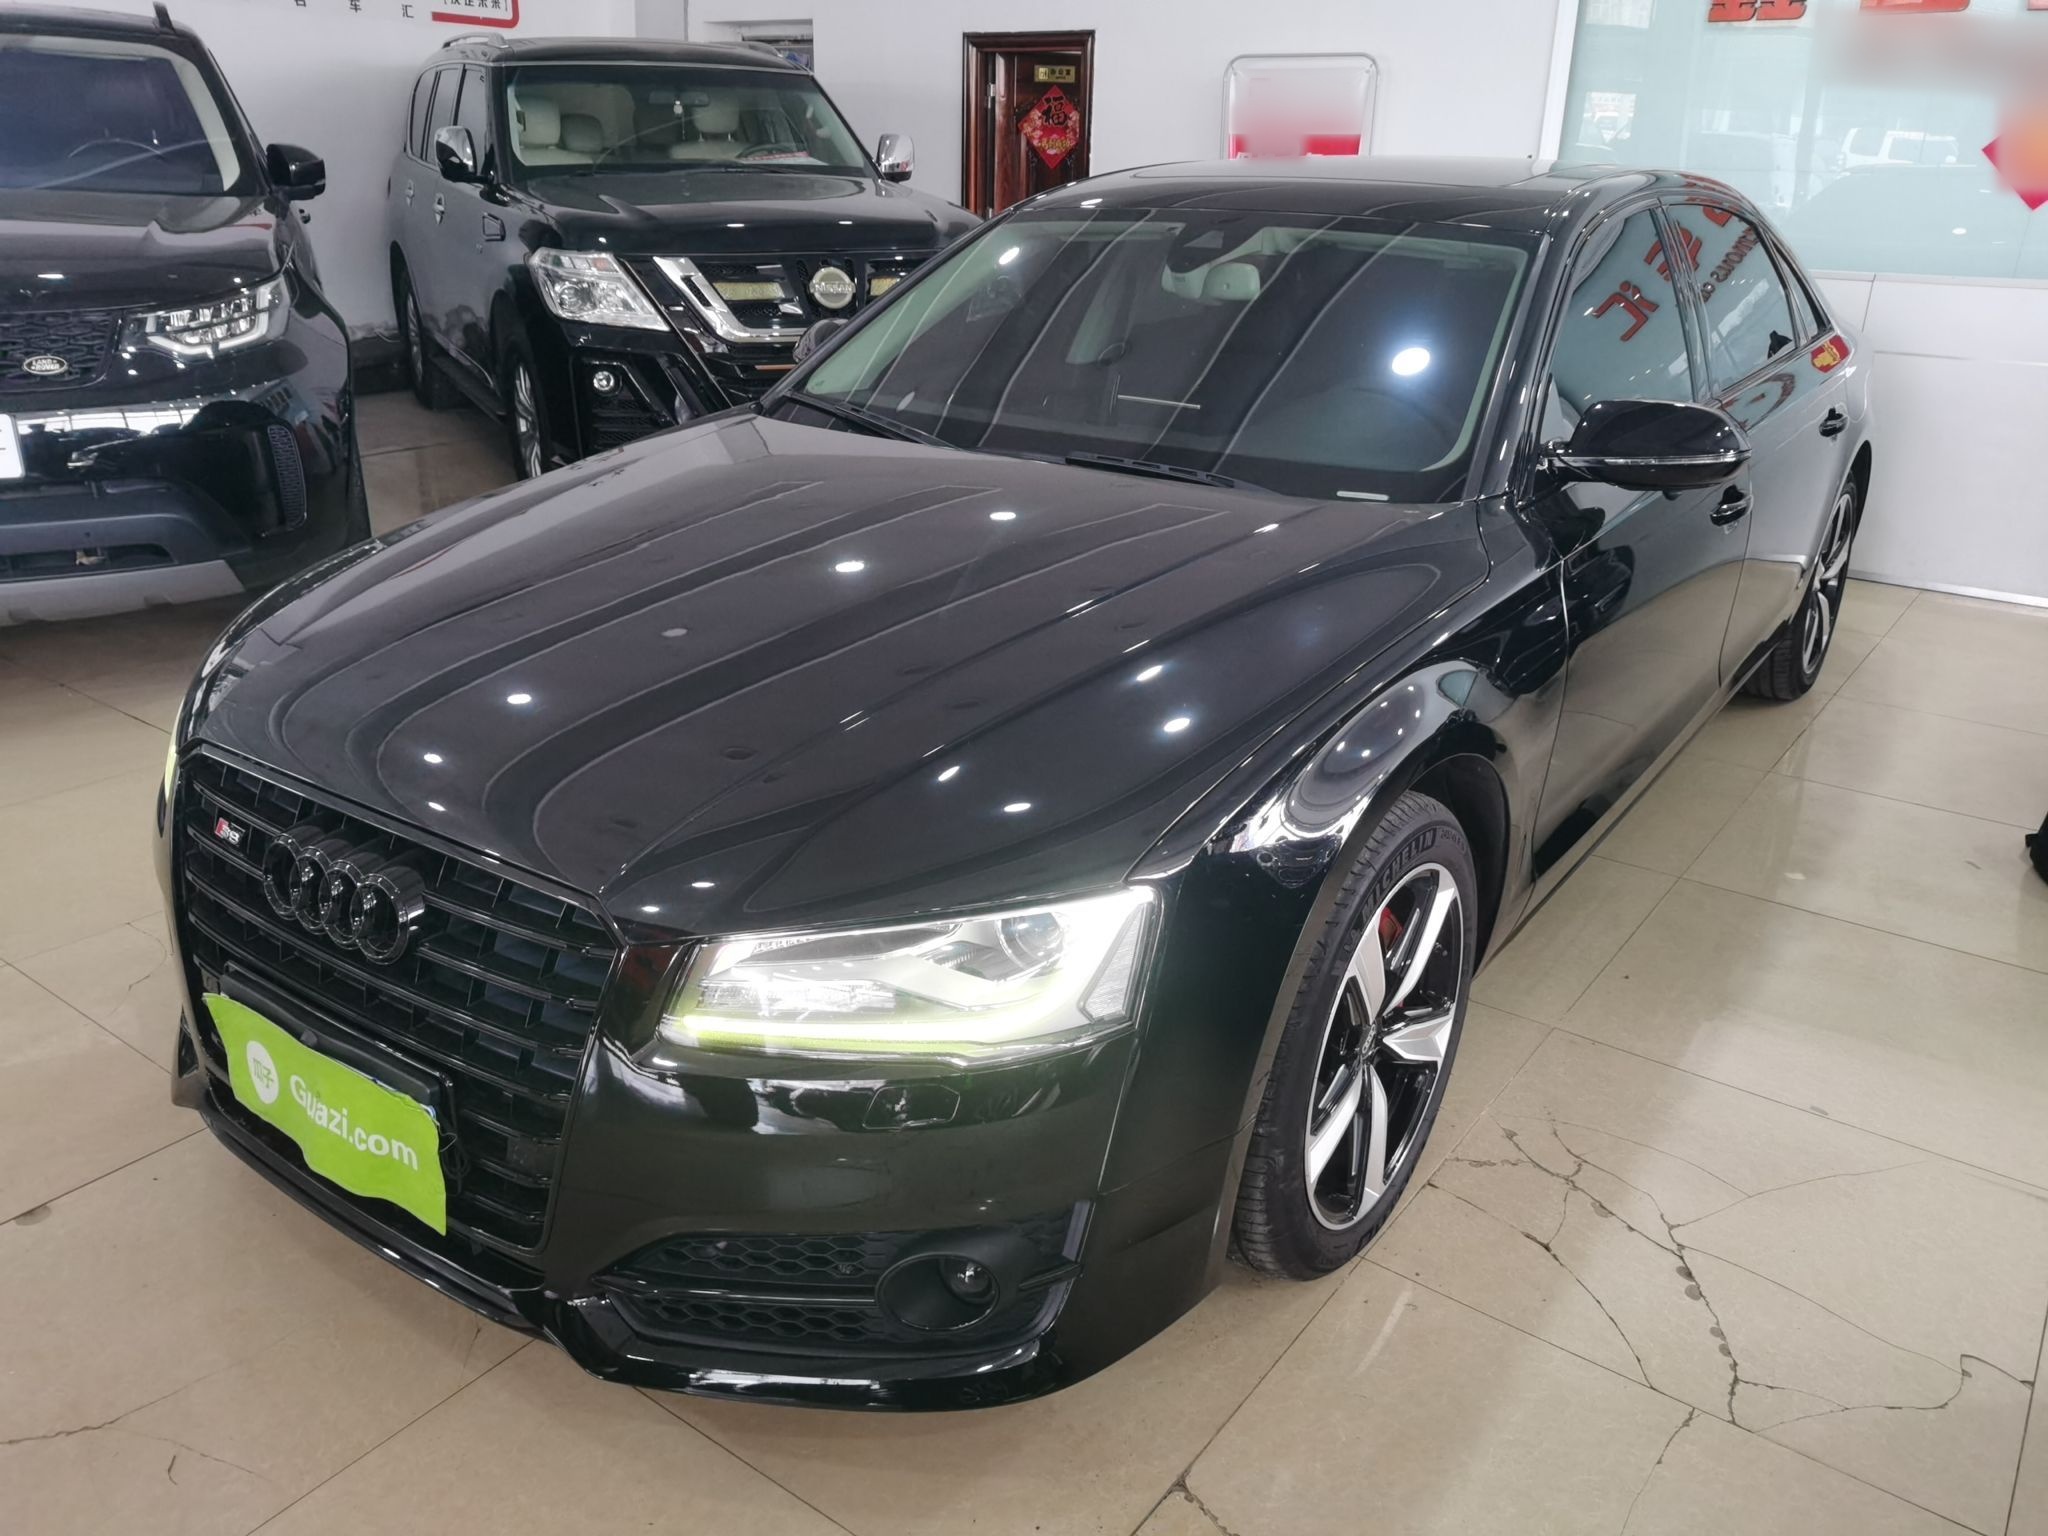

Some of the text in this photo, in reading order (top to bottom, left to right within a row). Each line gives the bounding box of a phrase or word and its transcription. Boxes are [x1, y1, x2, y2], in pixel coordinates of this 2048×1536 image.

[1042, 95, 1070, 126] 福
[814, 282, 852, 294] NISSAN
[1361, 827, 1437, 922] MICHELIN
[289, 1073, 419, 1172] Guazi.com
